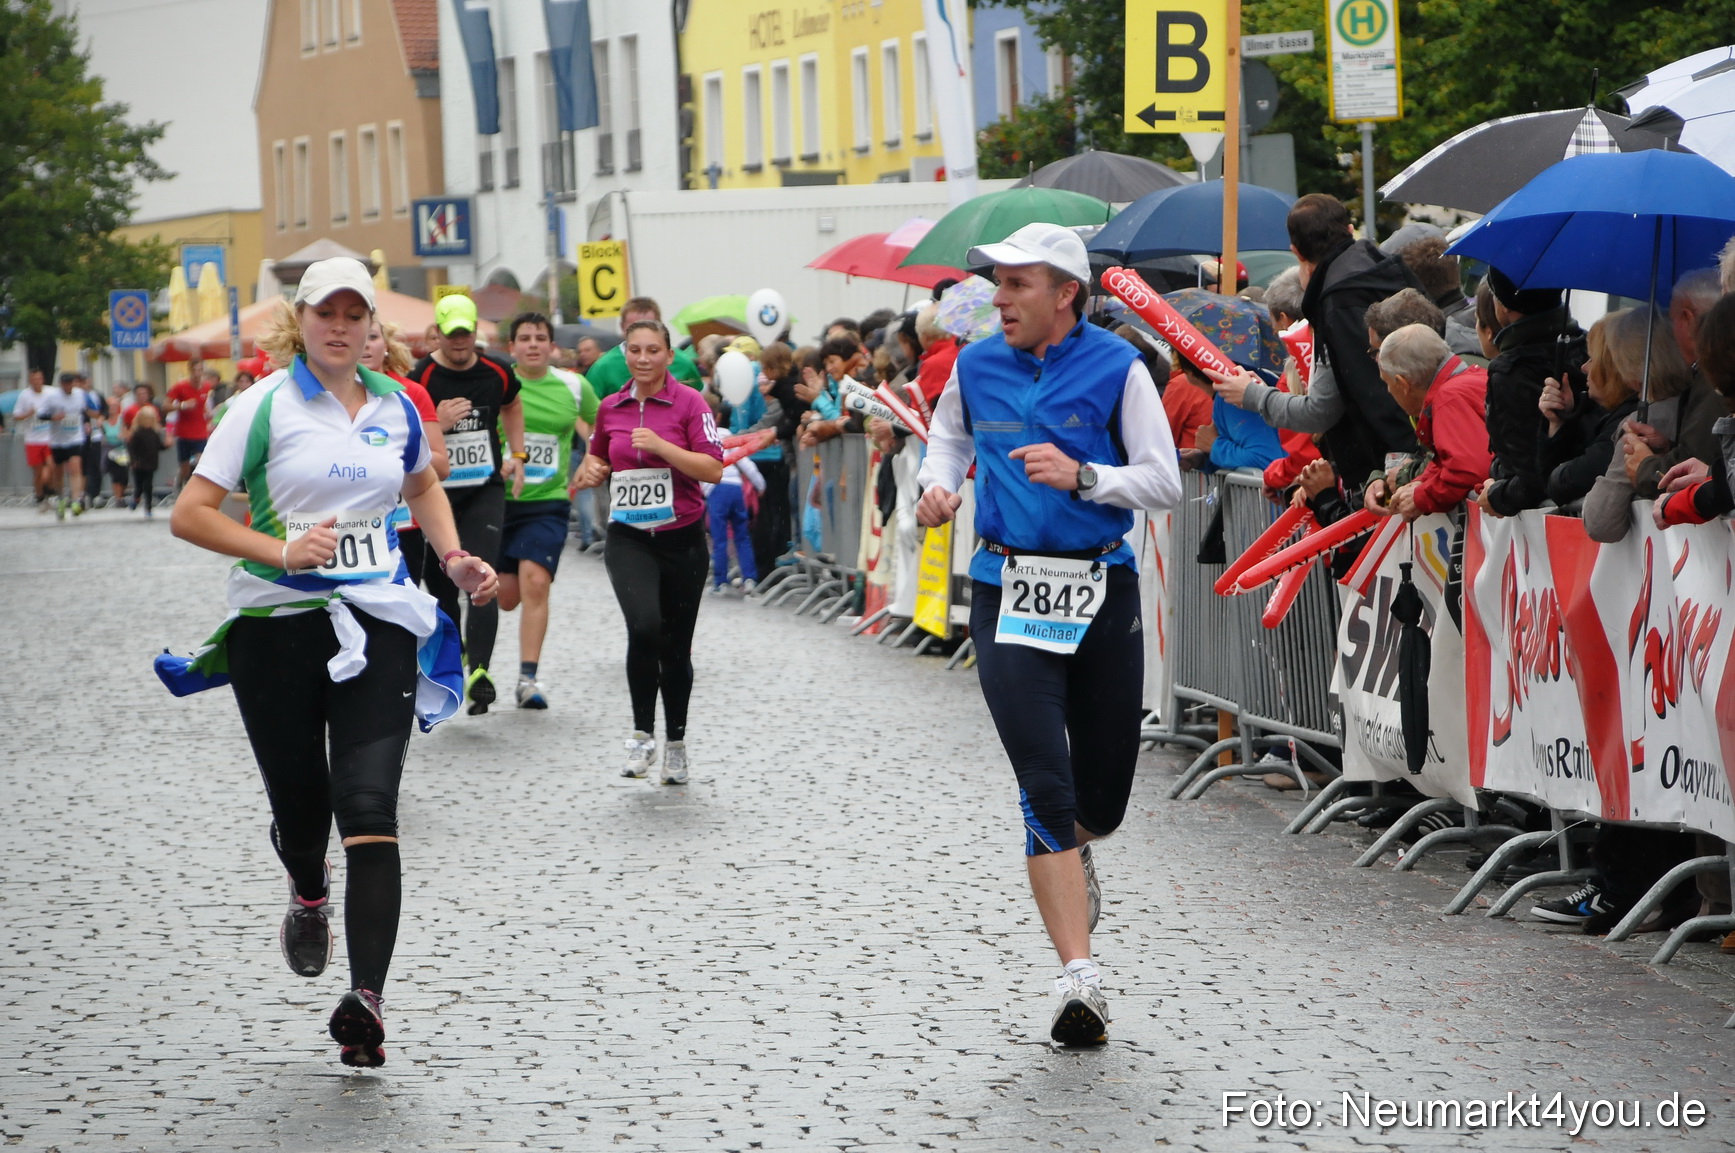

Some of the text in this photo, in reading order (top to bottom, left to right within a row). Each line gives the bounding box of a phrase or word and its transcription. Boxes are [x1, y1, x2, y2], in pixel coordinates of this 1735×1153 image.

[749, 9, 786, 50] HOTEL
[1350, 5, 1375, 34] H
[1155, 10, 1211, 93] B
[1245, 36, 1308, 51] Ulmer Gasse
[1341, 51, 1386, 61] Marktplatz
[582, 246, 623, 260] Block
[591, 264, 617, 301] C
[1157, 314, 1195, 350] BKK
[447, 443, 488, 467] 2062
[328, 463, 367, 482] Anja
[617, 482, 666, 507] 2029
[625, 511, 658, 521] Andreas
[1004, 565, 1088, 580] PARTL Neumarkt
[1012, 579, 1096, 619] 2842
[1023, 622, 1078, 641] Michael
